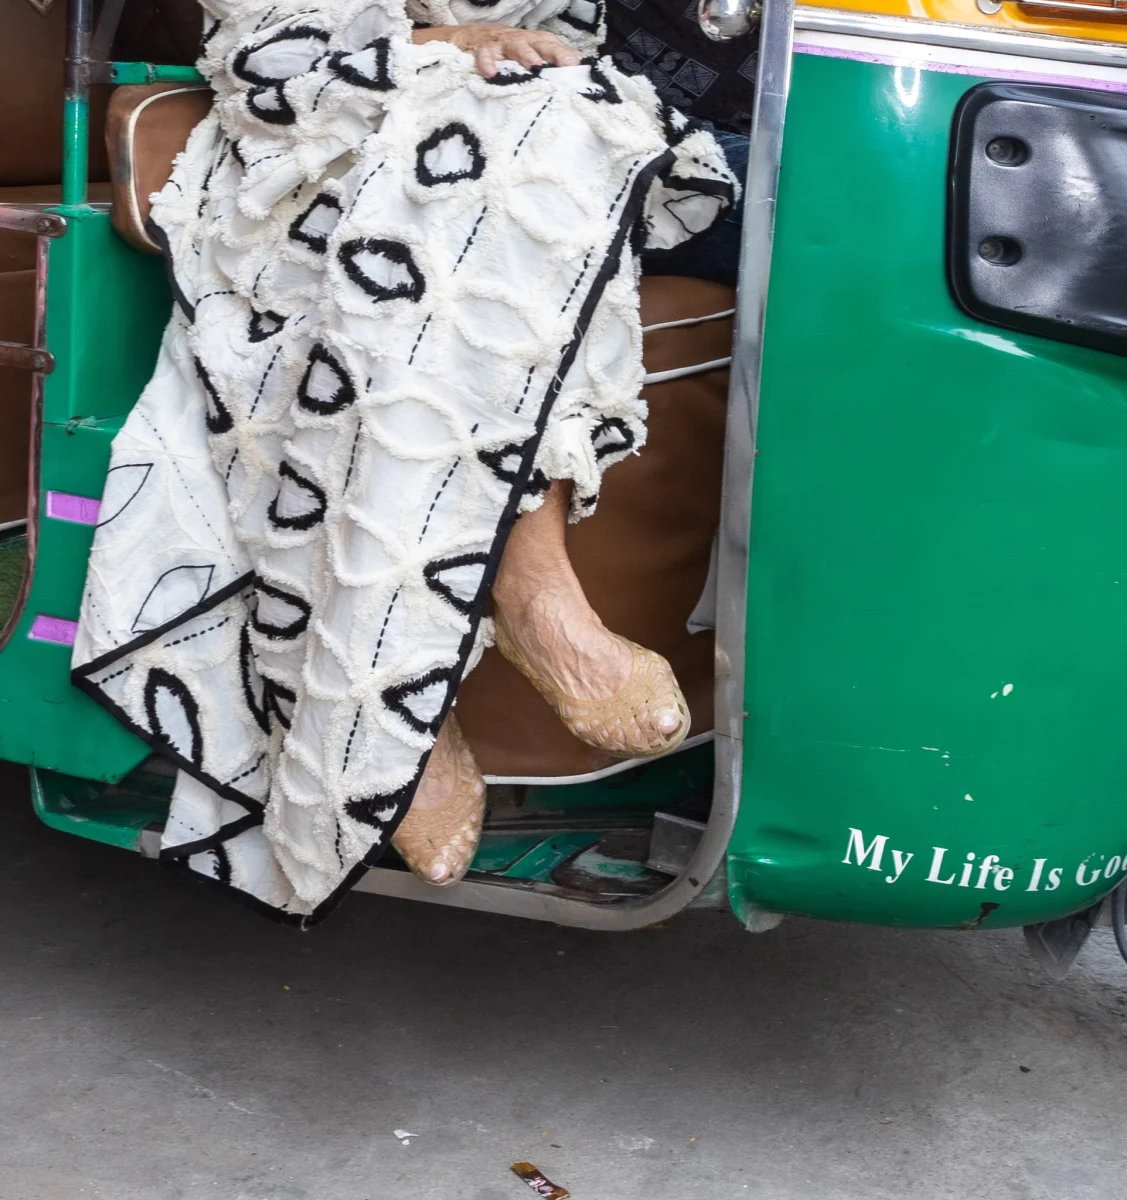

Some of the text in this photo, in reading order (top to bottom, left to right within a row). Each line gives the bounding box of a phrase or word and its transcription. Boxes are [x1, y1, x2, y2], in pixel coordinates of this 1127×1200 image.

[841, 827, 1127, 892] My Life Is Go
